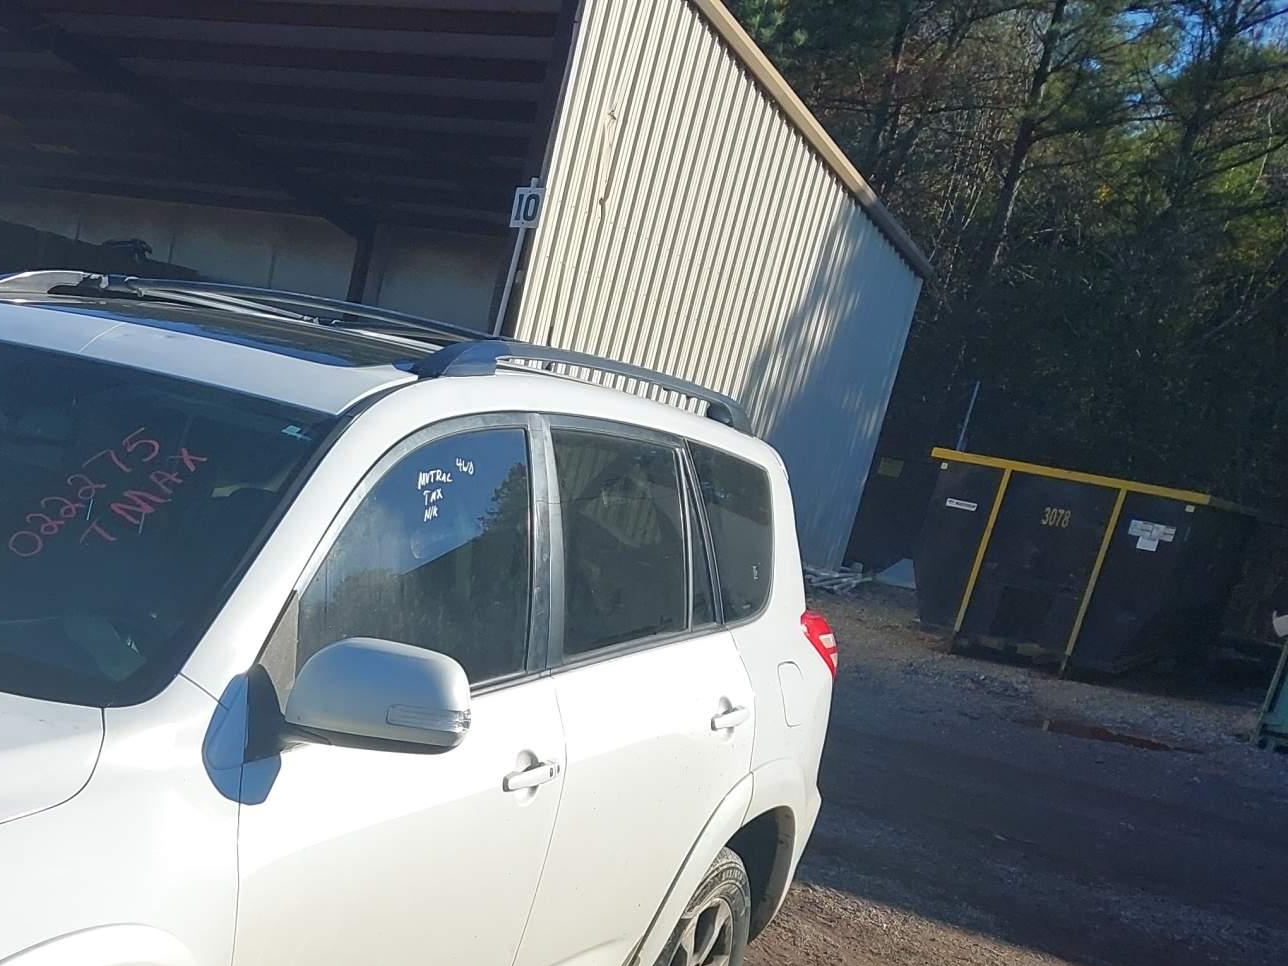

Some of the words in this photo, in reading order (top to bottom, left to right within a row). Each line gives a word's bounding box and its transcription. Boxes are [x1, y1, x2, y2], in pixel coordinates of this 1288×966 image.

[514, 193, 541, 222] 10
[423, 487, 443, 506] TAX
[1041, 506, 1072, 529] 3078
